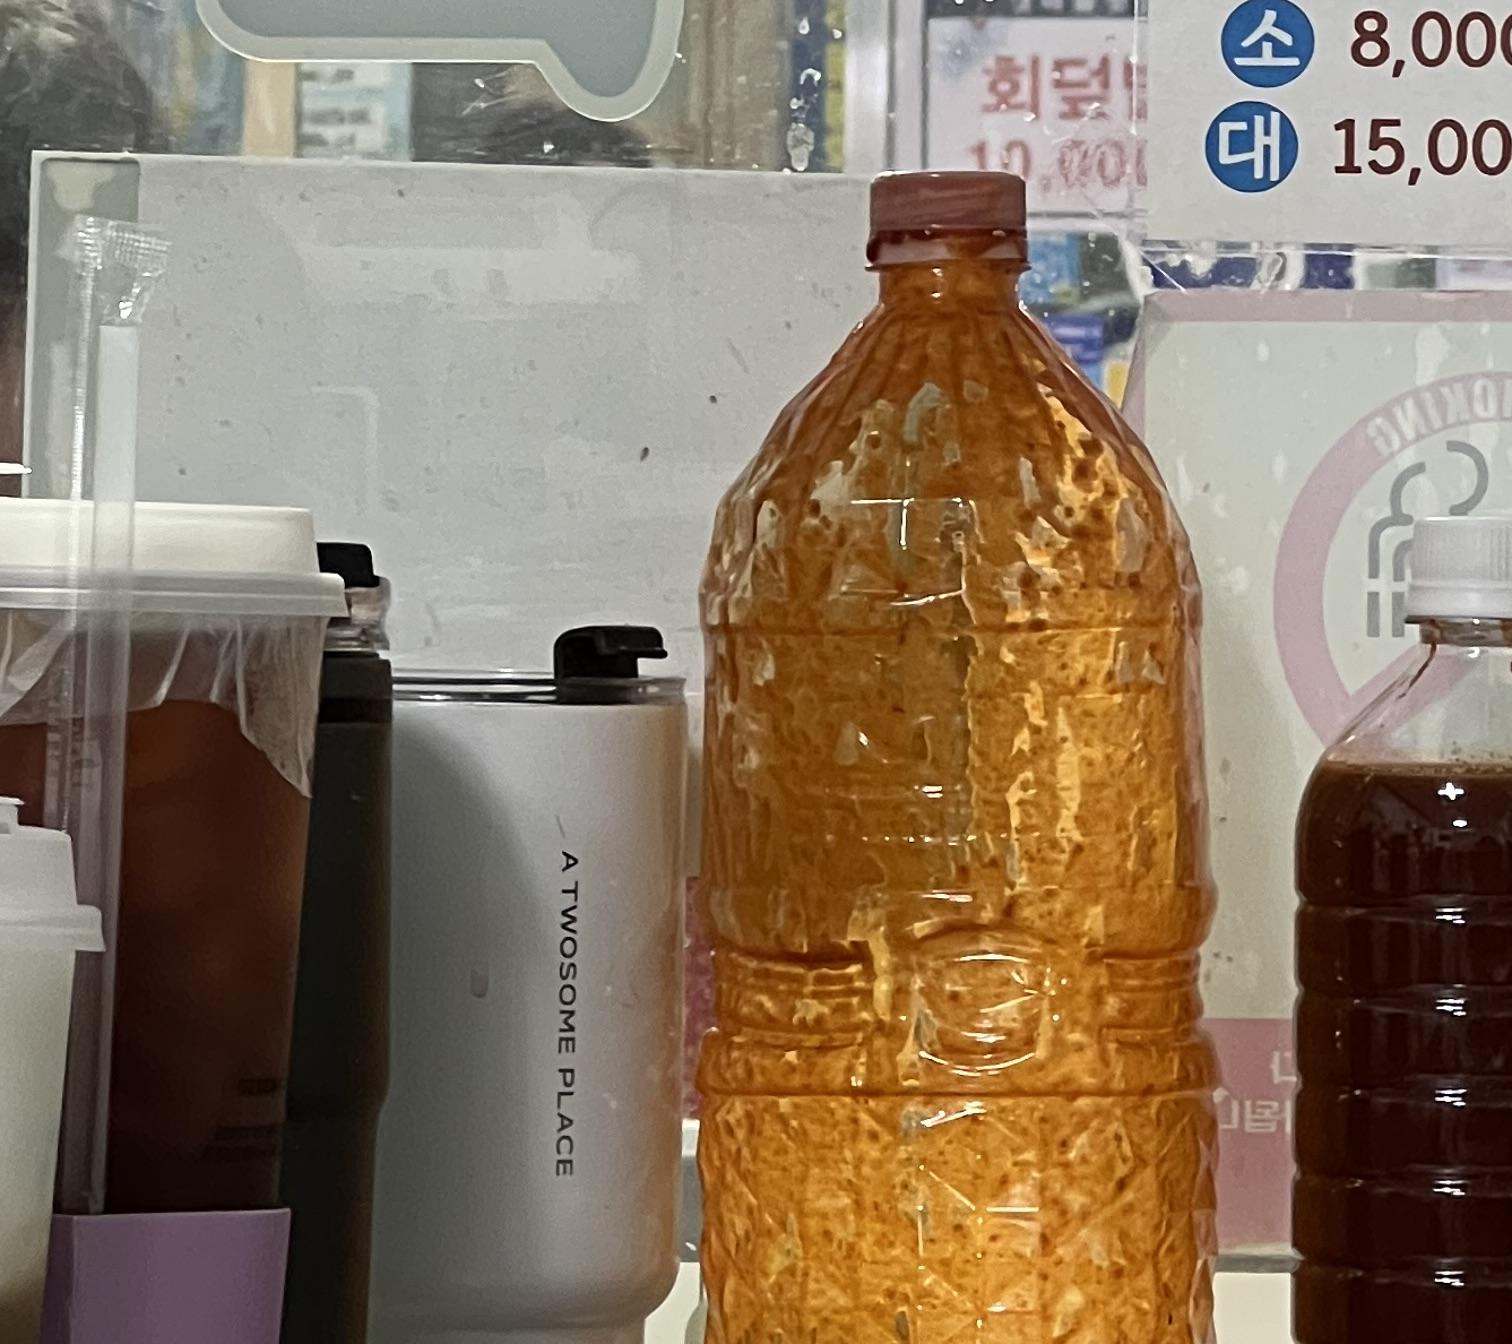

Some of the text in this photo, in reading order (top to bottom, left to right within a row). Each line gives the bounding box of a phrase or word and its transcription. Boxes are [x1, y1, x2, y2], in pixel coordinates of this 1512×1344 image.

[1233, 10, 1301, 67] 소
[1217, 110, 1282, 181] 대
[555, 850, 580, 1178] A TWOSOME PLACE
